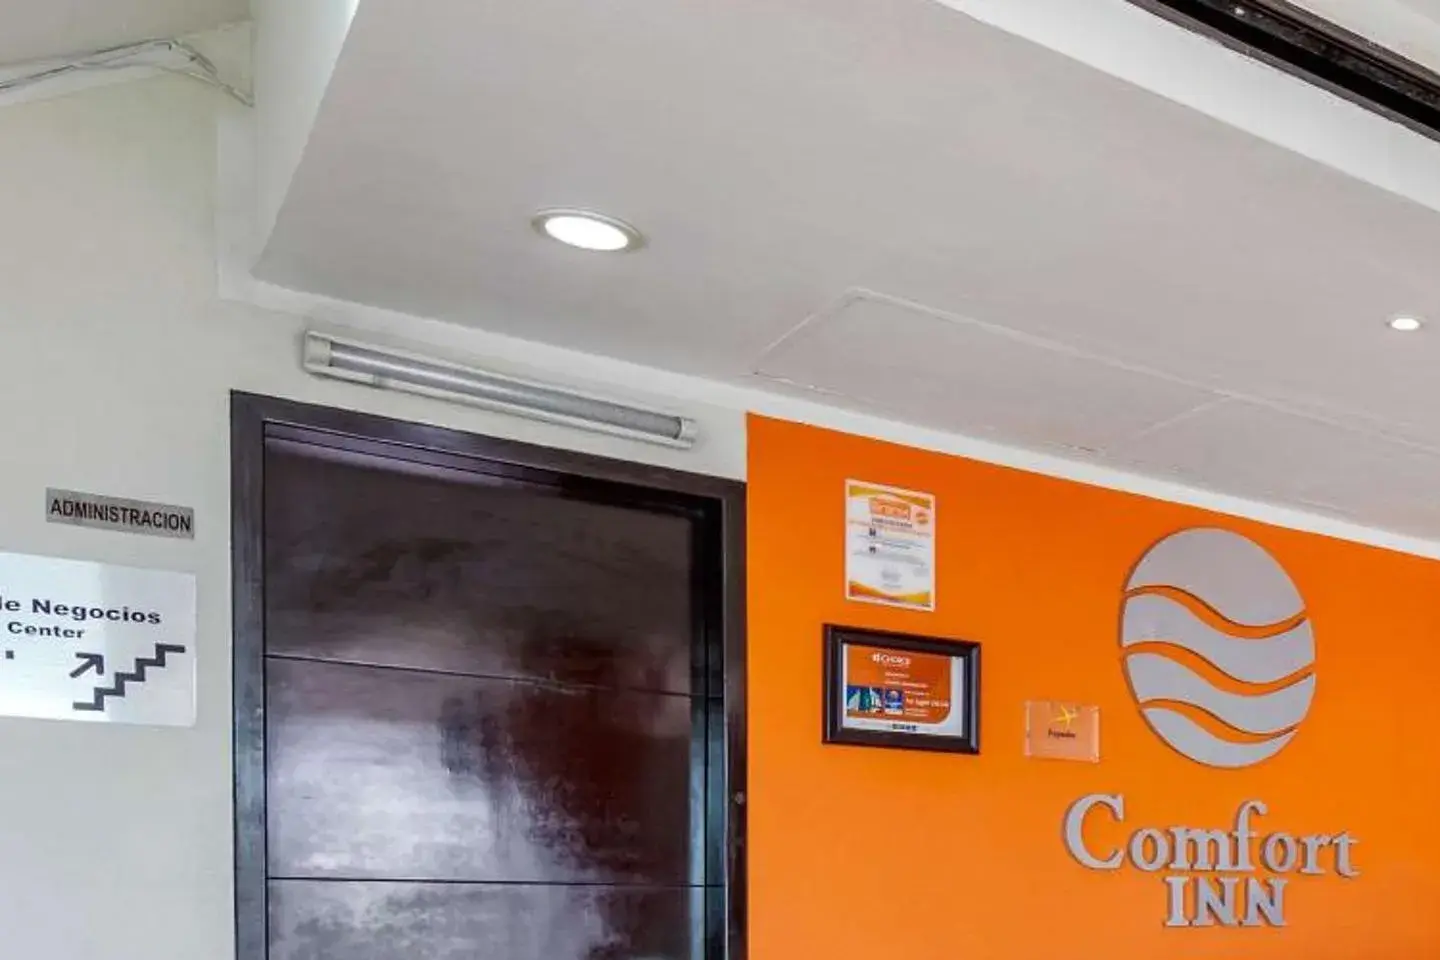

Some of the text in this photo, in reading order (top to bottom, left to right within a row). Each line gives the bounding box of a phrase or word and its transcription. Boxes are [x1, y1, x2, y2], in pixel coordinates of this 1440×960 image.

[50, 498, 192, 532] ADMINISTRACION
[31, 598, 162, 625] Negocios
[7, 620, 86, 639] Center
[1061, 792, 1361, 878] Comfort
[1163, 875, 1289, 928] INN
